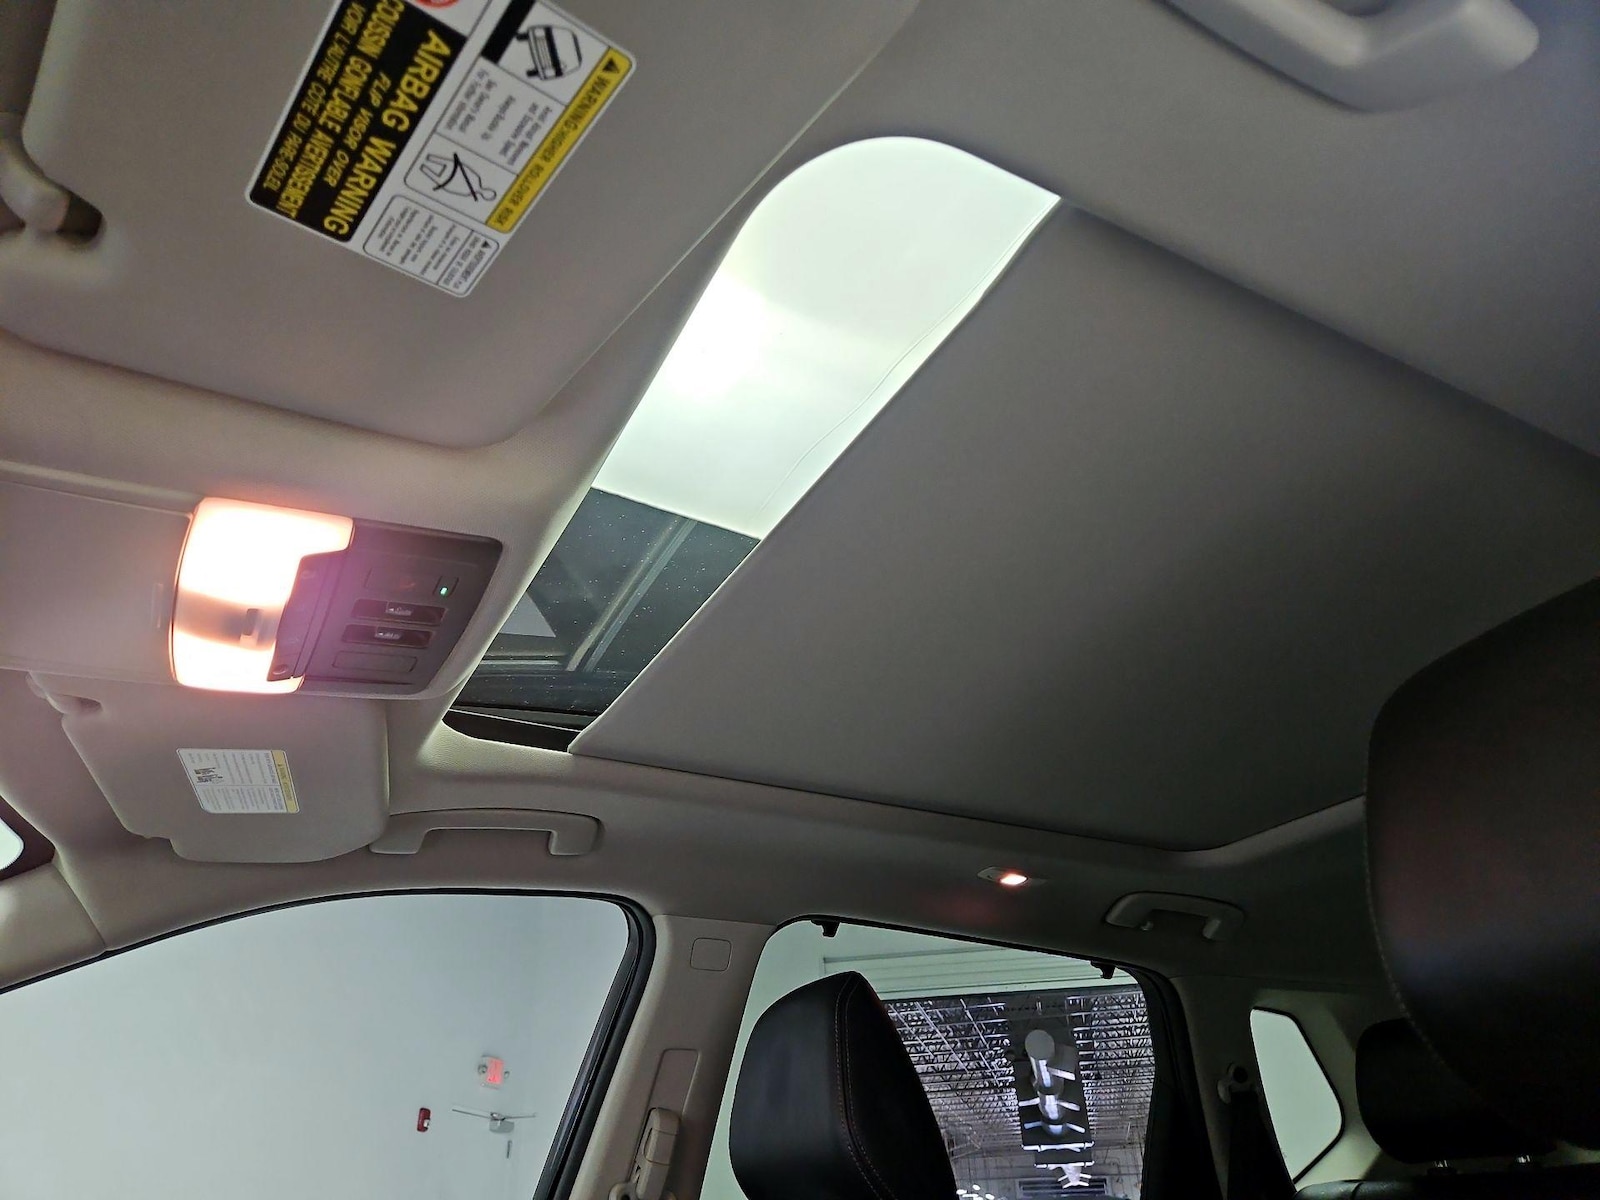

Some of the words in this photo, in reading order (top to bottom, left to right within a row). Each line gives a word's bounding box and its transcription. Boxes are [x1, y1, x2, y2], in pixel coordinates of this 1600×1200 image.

[342, 3, 364, 34] VOIR
[357, 0, 404, 58] COUSSIN
[318, 33, 349, 84] L'AUTRE
[382, 30, 450, 131] AIRBAG
[319, 56, 372, 133] GONFLABLE
[370, 73, 390, 106] FLIP
[294, 113, 311, 132] DU
[344, 108, 372, 149] VISOR
[264, 132, 302, 190] PARE-SOLEIL
[277, 129, 333, 218] AVERTISSEMENT
[324, 150, 349, 186] OVER
[324, 137, 396, 234] WARNING
[510, 164, 544, 206] ROLLOVER
[496, 207, 514, 225] RISK
